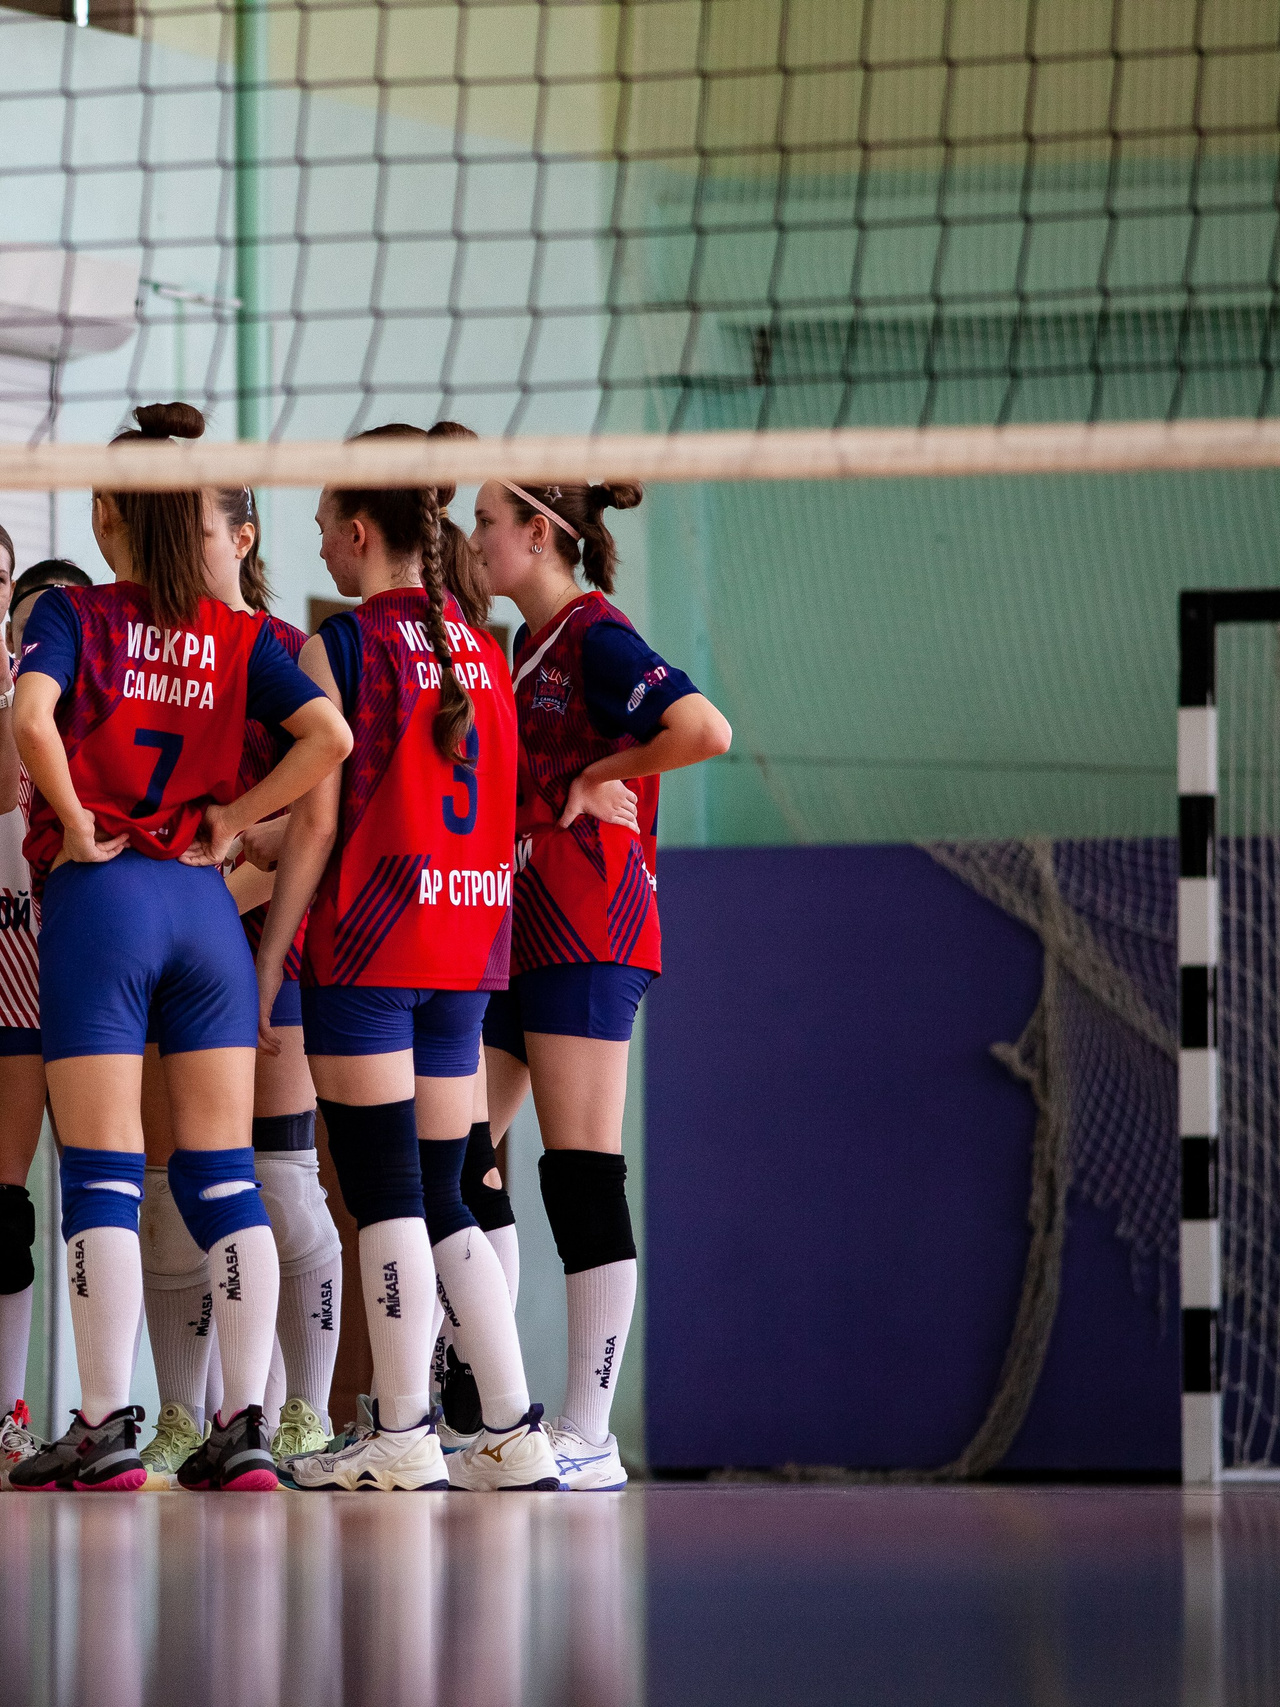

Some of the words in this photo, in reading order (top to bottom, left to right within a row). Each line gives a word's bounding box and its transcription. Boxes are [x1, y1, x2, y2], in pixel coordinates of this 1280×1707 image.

[127, 621, 215, 671] ИСКРА
[396, 620, 481, 652] ИСРА
[123, 669, 214, 710] САМАРА
[416, 661, 492, 690] СААРА
[653, 666, 667, 681] 17
[133, 728, 184, 819] 7
[442, 722, 479, 835] 3
[419, 868, 443, 905] АР
[448, 863, 511, 907] СТРОЙ
[75, 1239, 89, 1298] MIKASA
[225, 1243, 242, 1301] MIKASA
[385, 1261, 401, 1319] MIKASA
[195, 1292, 212, 1336] MIKASA
[320, 1279, 334, 1331] MIKASA
[434, 1336, 446, 1382] MIKASA
[599, 1335, 616, 1389] MIKASA
